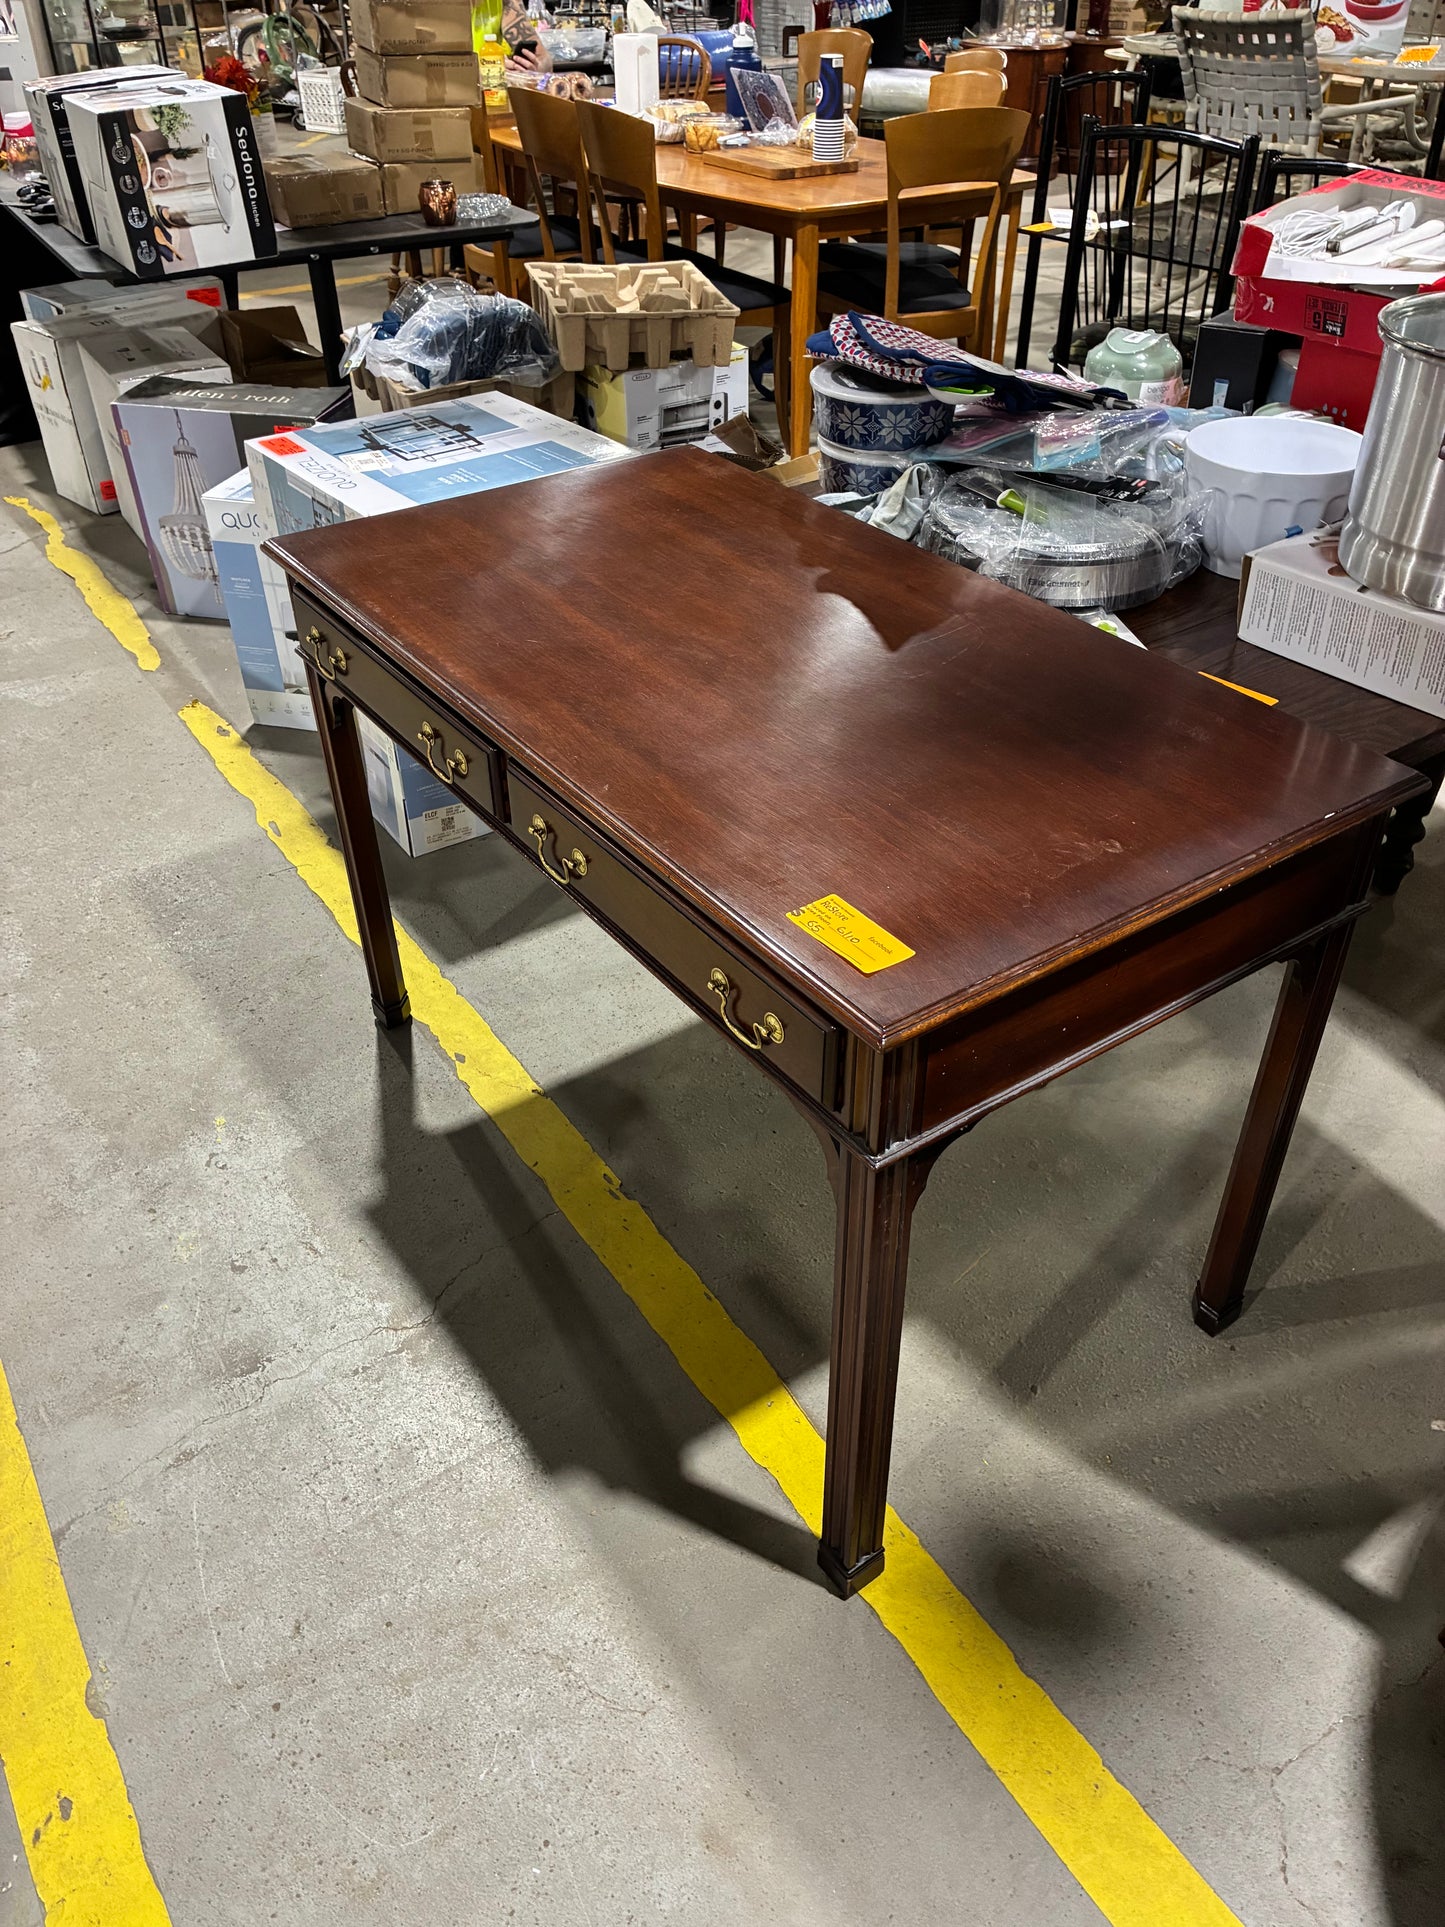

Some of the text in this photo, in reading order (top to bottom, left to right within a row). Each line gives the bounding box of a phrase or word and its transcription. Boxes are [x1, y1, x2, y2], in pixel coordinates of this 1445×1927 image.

[235, 126, 262, 227] Sedona kitchen
[244, 395, 293, 404] roth
[297, 456, 359, 490] QUOIZEL
[821, 901, 849, 922] ReStore
[807, 920, 825, 934] 65
[868, 937, 893, 954] facebook
